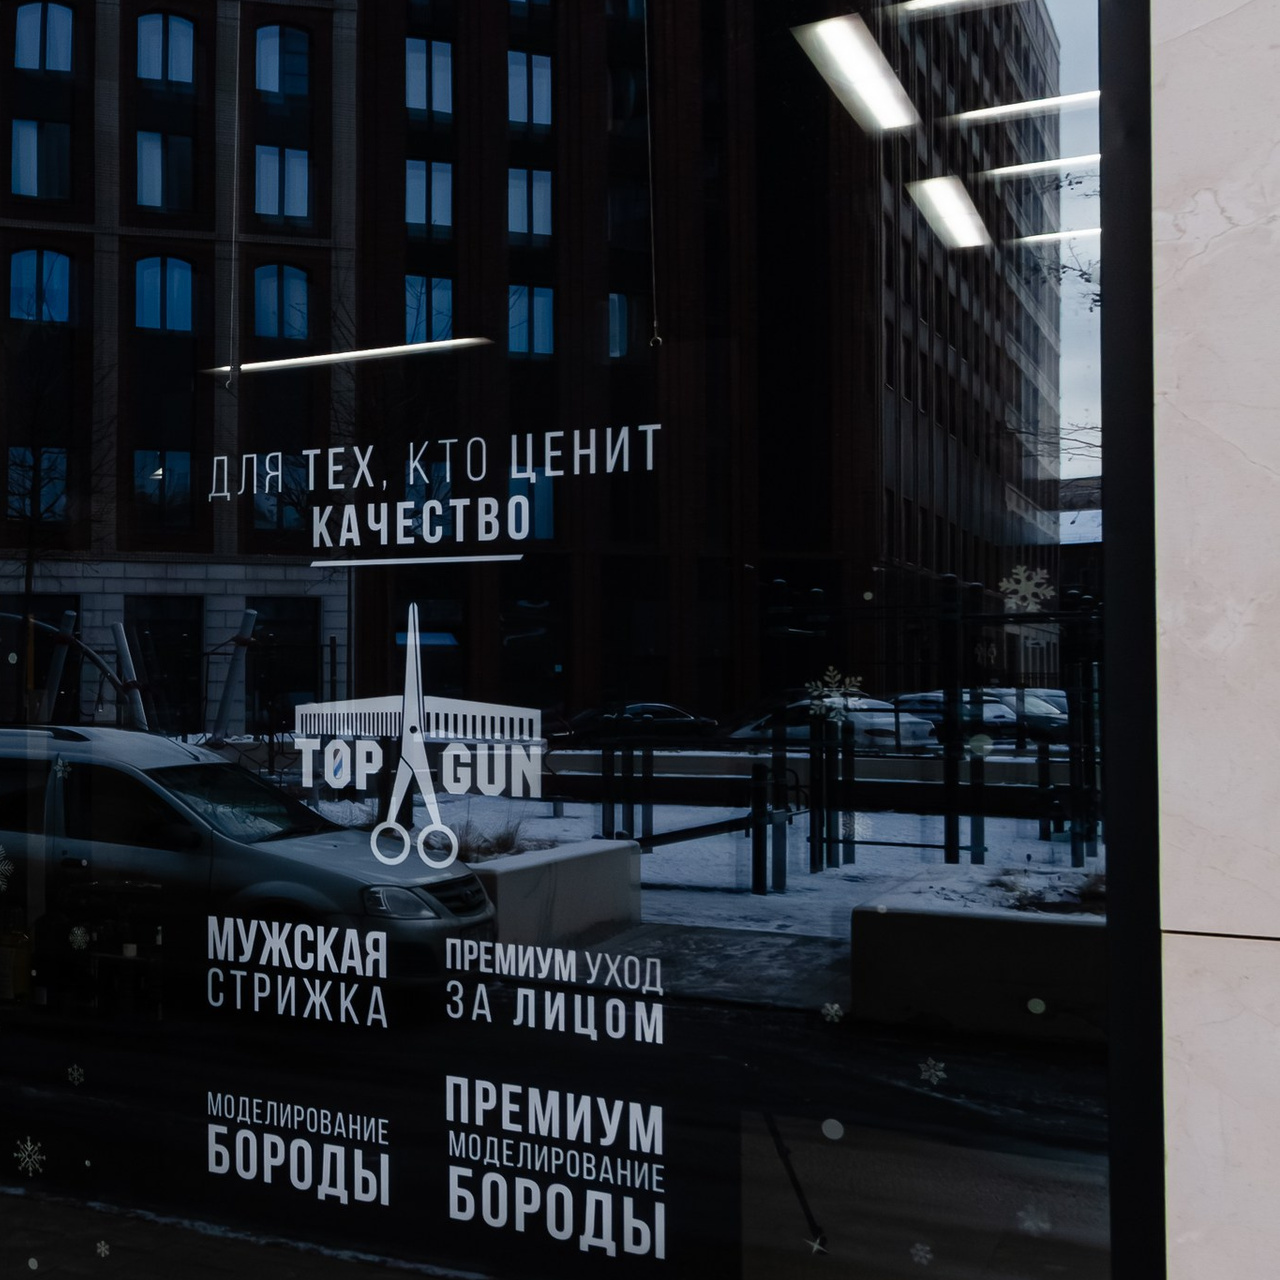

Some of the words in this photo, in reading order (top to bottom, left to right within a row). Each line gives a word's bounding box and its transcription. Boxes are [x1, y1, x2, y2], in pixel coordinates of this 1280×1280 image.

[208, 451, 283, 502] ДЛЯ
[302, 444, 388, 492] ТЕХ,
[408, 436, 487, 485] КТО
[510, 423, 662, 484] ЦЕНИТ
[312, 494, 530, 548] КАЧЕСТВО
[294, 737, 384, 791] TOP
[442, 742, 542, 798] GUN
[207, 915, 387, 979] МУЖСКАЯ
[446, 937, 576, 982] ПРЕМИУМ
[585, 950, 664, 996] УХОД
[207, 967, 388, 1029] СТРИЖКА
[446, 979, 492, 1022] ЗА
[513, 987, 664, 1044] ЛИЦОМ
[207, 1091, 389, 1145] МОДЕЛИРОВАНИЕ
[446, 1074, 664, 1156] ПРЕМИУМ
[207, 1123, 390, 1206] БОРОДЫ
[448, 1129, 665, 1193] МОДЕЛИРОВАНИЕ
[448, 1165, 666, 1260] БОРОДЫ
